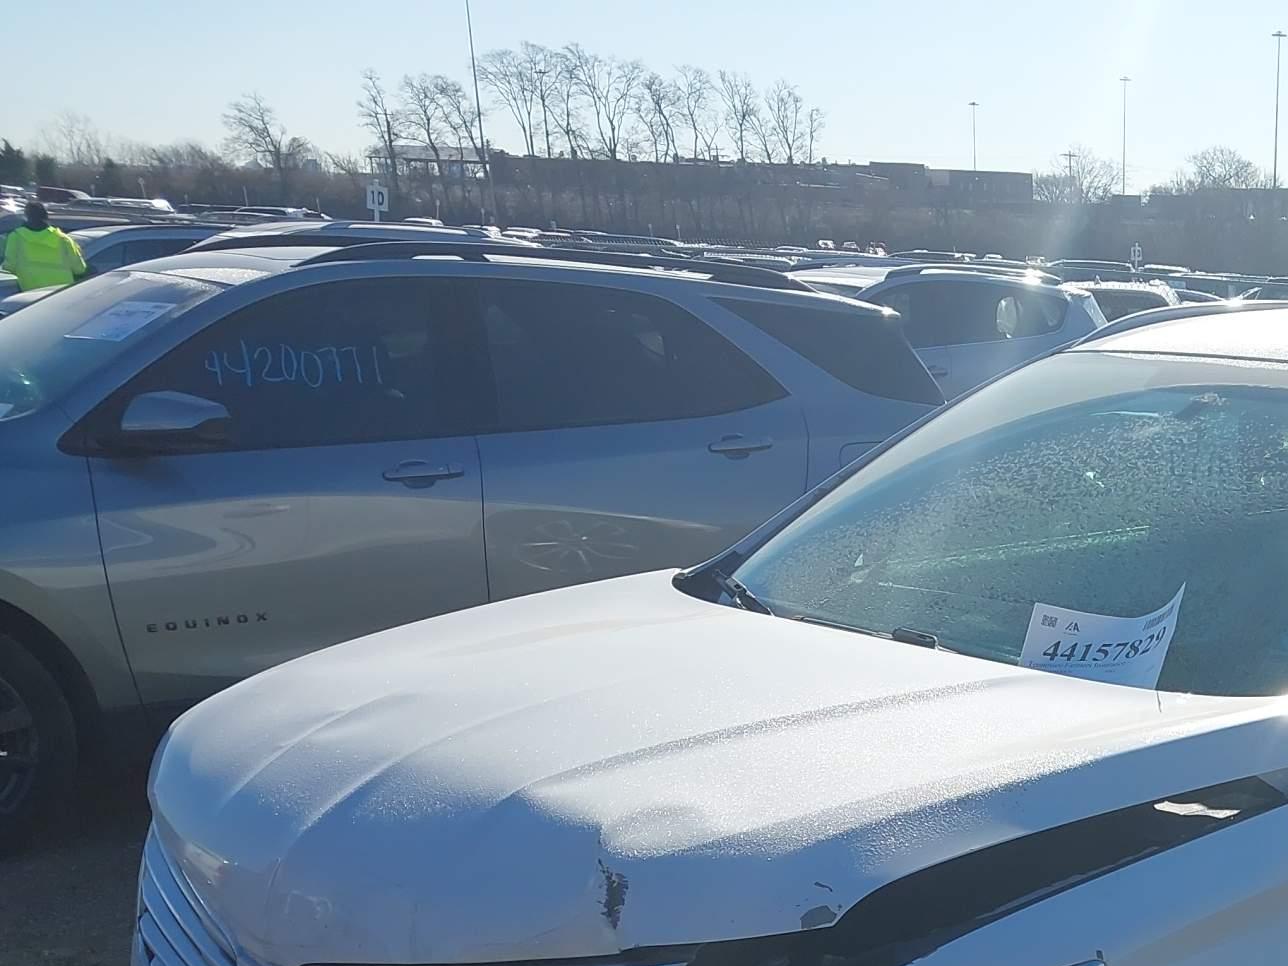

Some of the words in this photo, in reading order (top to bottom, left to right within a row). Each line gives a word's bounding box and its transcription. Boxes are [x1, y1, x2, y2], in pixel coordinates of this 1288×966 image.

[205, 337, 383, 388] 44200771
[145, 612, 268, 633] EQUINOX
[1042, 627, 1167, 662] 44157829
